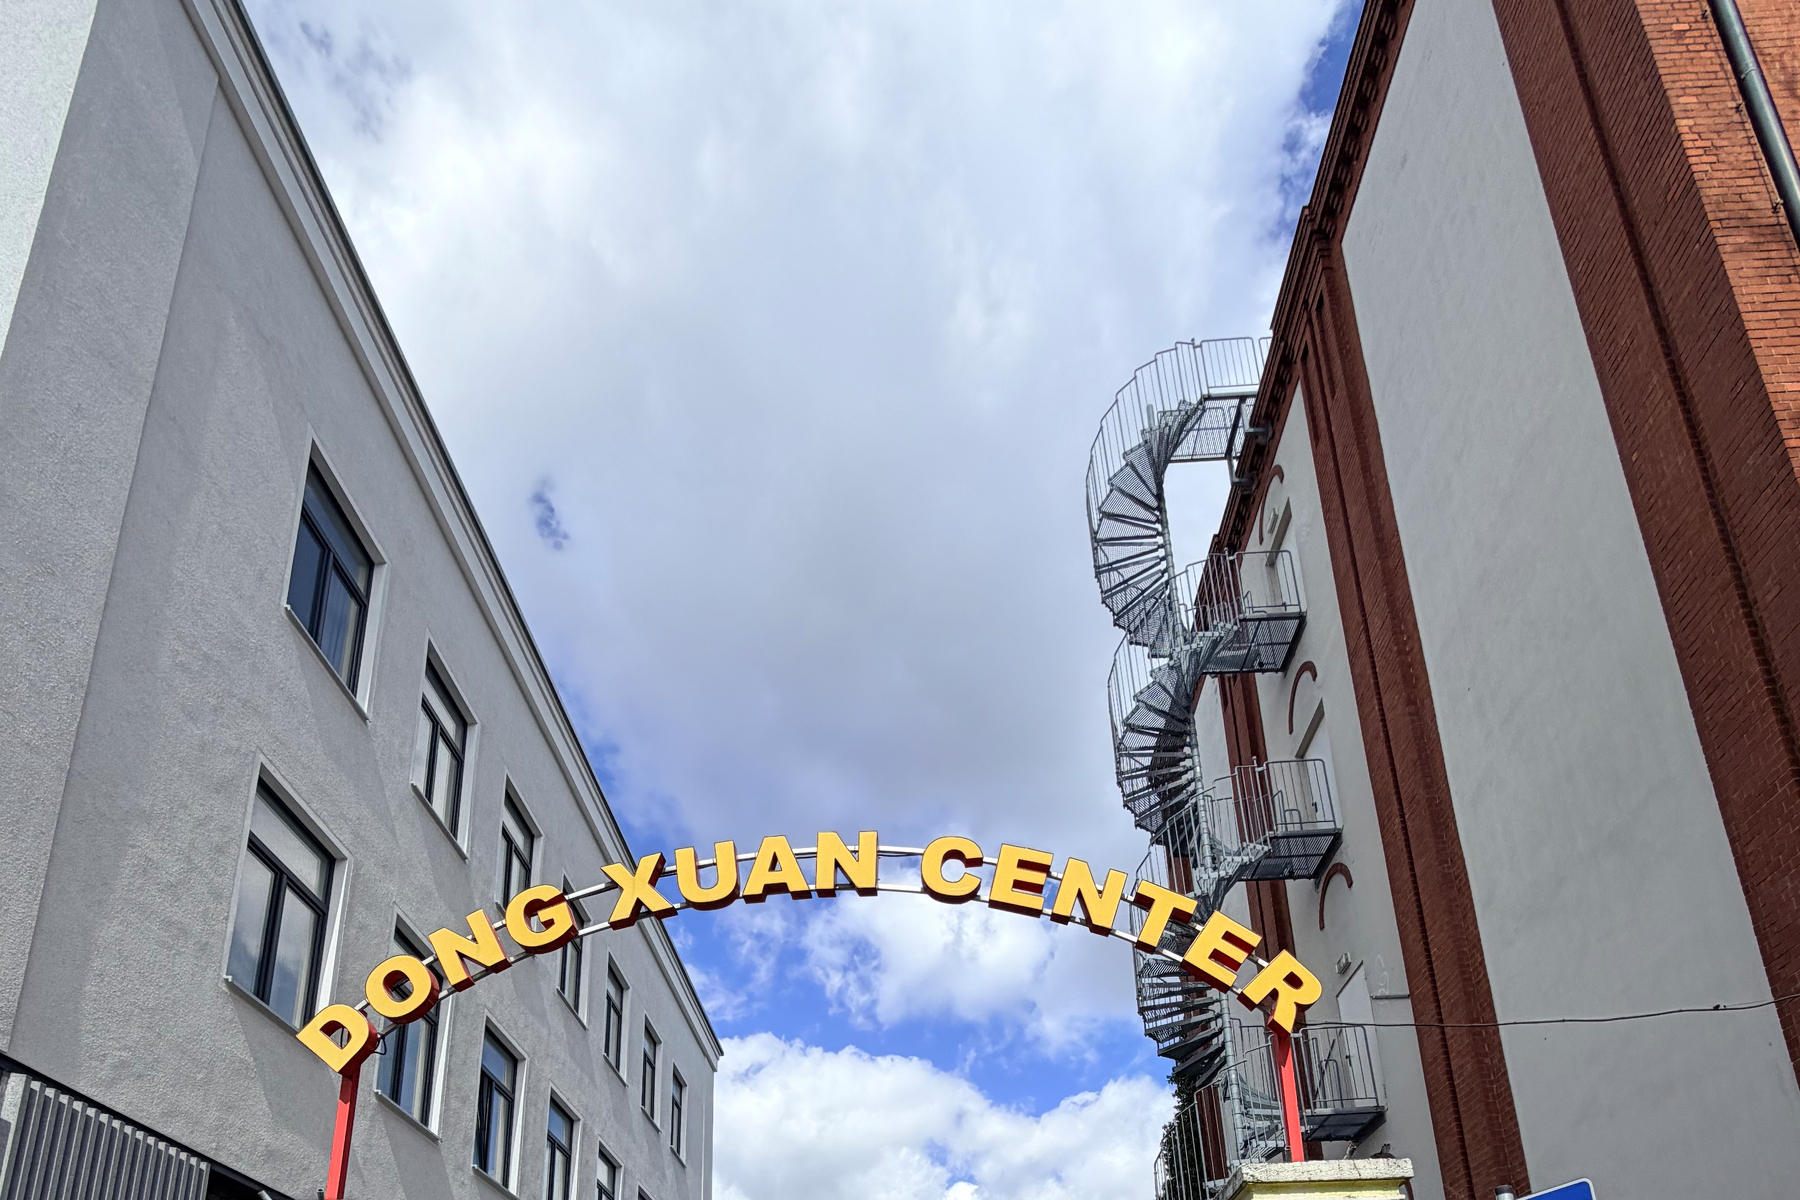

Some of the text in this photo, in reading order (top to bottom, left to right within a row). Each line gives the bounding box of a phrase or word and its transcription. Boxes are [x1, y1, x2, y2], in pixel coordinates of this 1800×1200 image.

[296, 830, 1323, 1073] DONG XUAN CENTER
